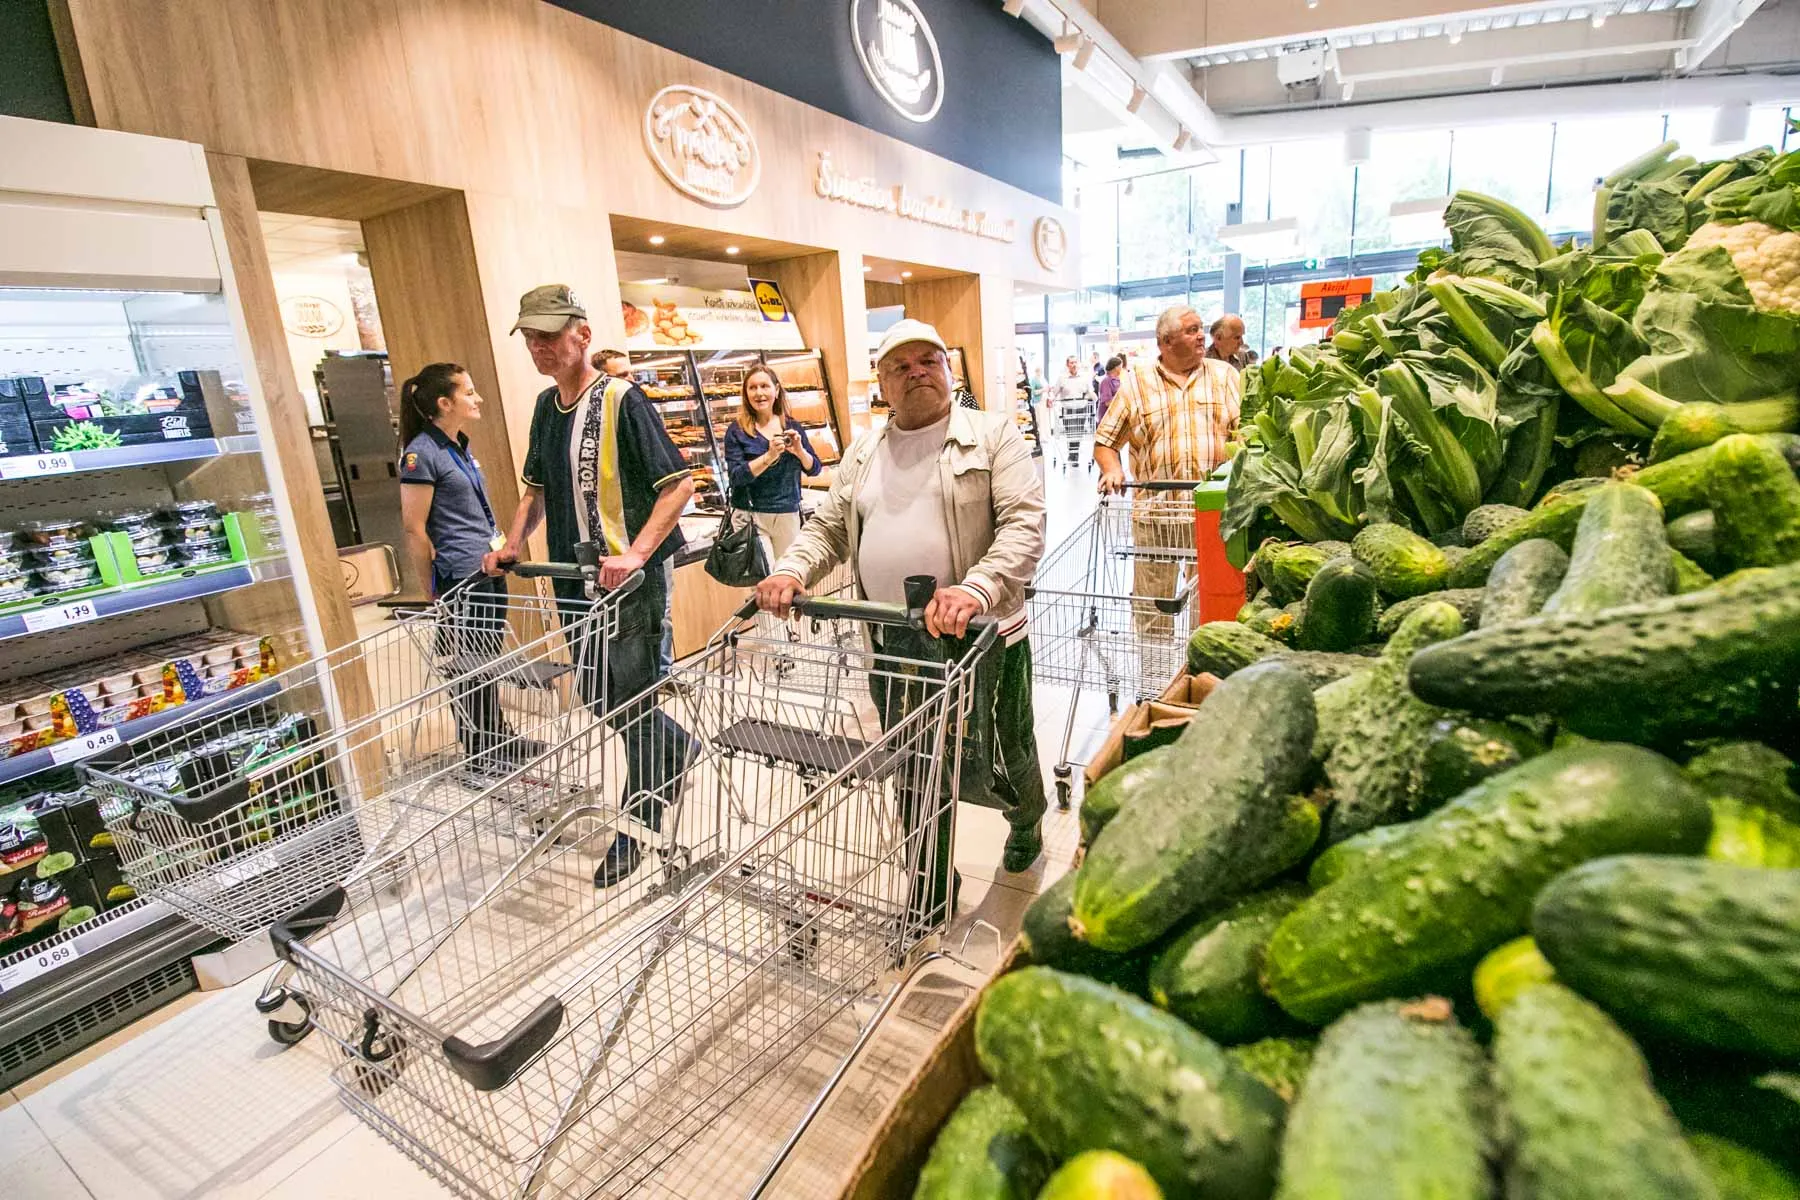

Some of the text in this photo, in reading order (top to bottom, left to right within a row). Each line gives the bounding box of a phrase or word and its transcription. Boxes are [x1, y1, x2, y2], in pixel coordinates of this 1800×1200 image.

[580, 437, 598, 492] BOARD
[63, 604, 90, 620] 1,79
[86, 733, 114, 750] 0,49
[39, 947, 70, 968] 0,69
